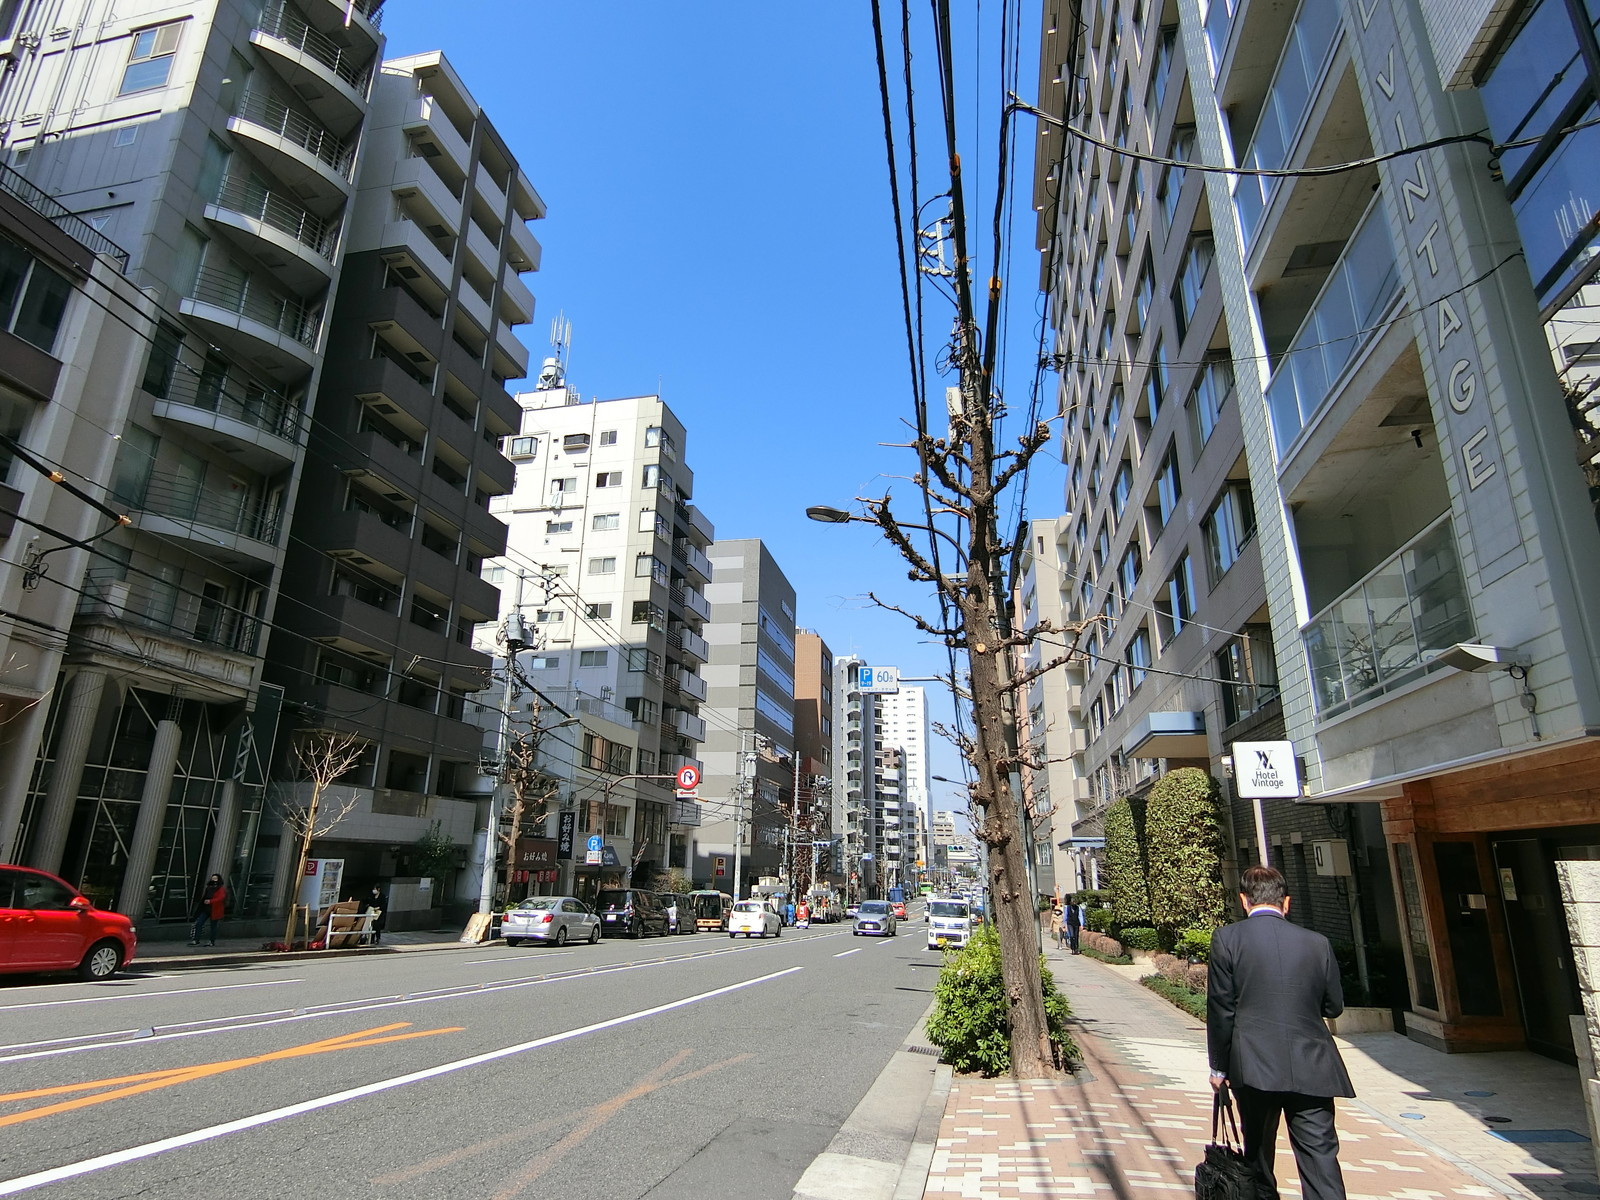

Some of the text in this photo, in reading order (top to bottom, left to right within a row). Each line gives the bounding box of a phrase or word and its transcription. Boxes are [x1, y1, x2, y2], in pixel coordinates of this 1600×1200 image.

[1376, 45, 1497, 491] VINTAGE
[864, 669, 870, 680] P
[877, 671, 893, 682] 60分
[1255, 771, 1278, 779] Hotel
[1252, 779, 1283, 789] Vintage
[560, 814, 572, 853] お好み焼
[591, 840, 598, 851] P
[523, 851, 548, 862] お好み焼
